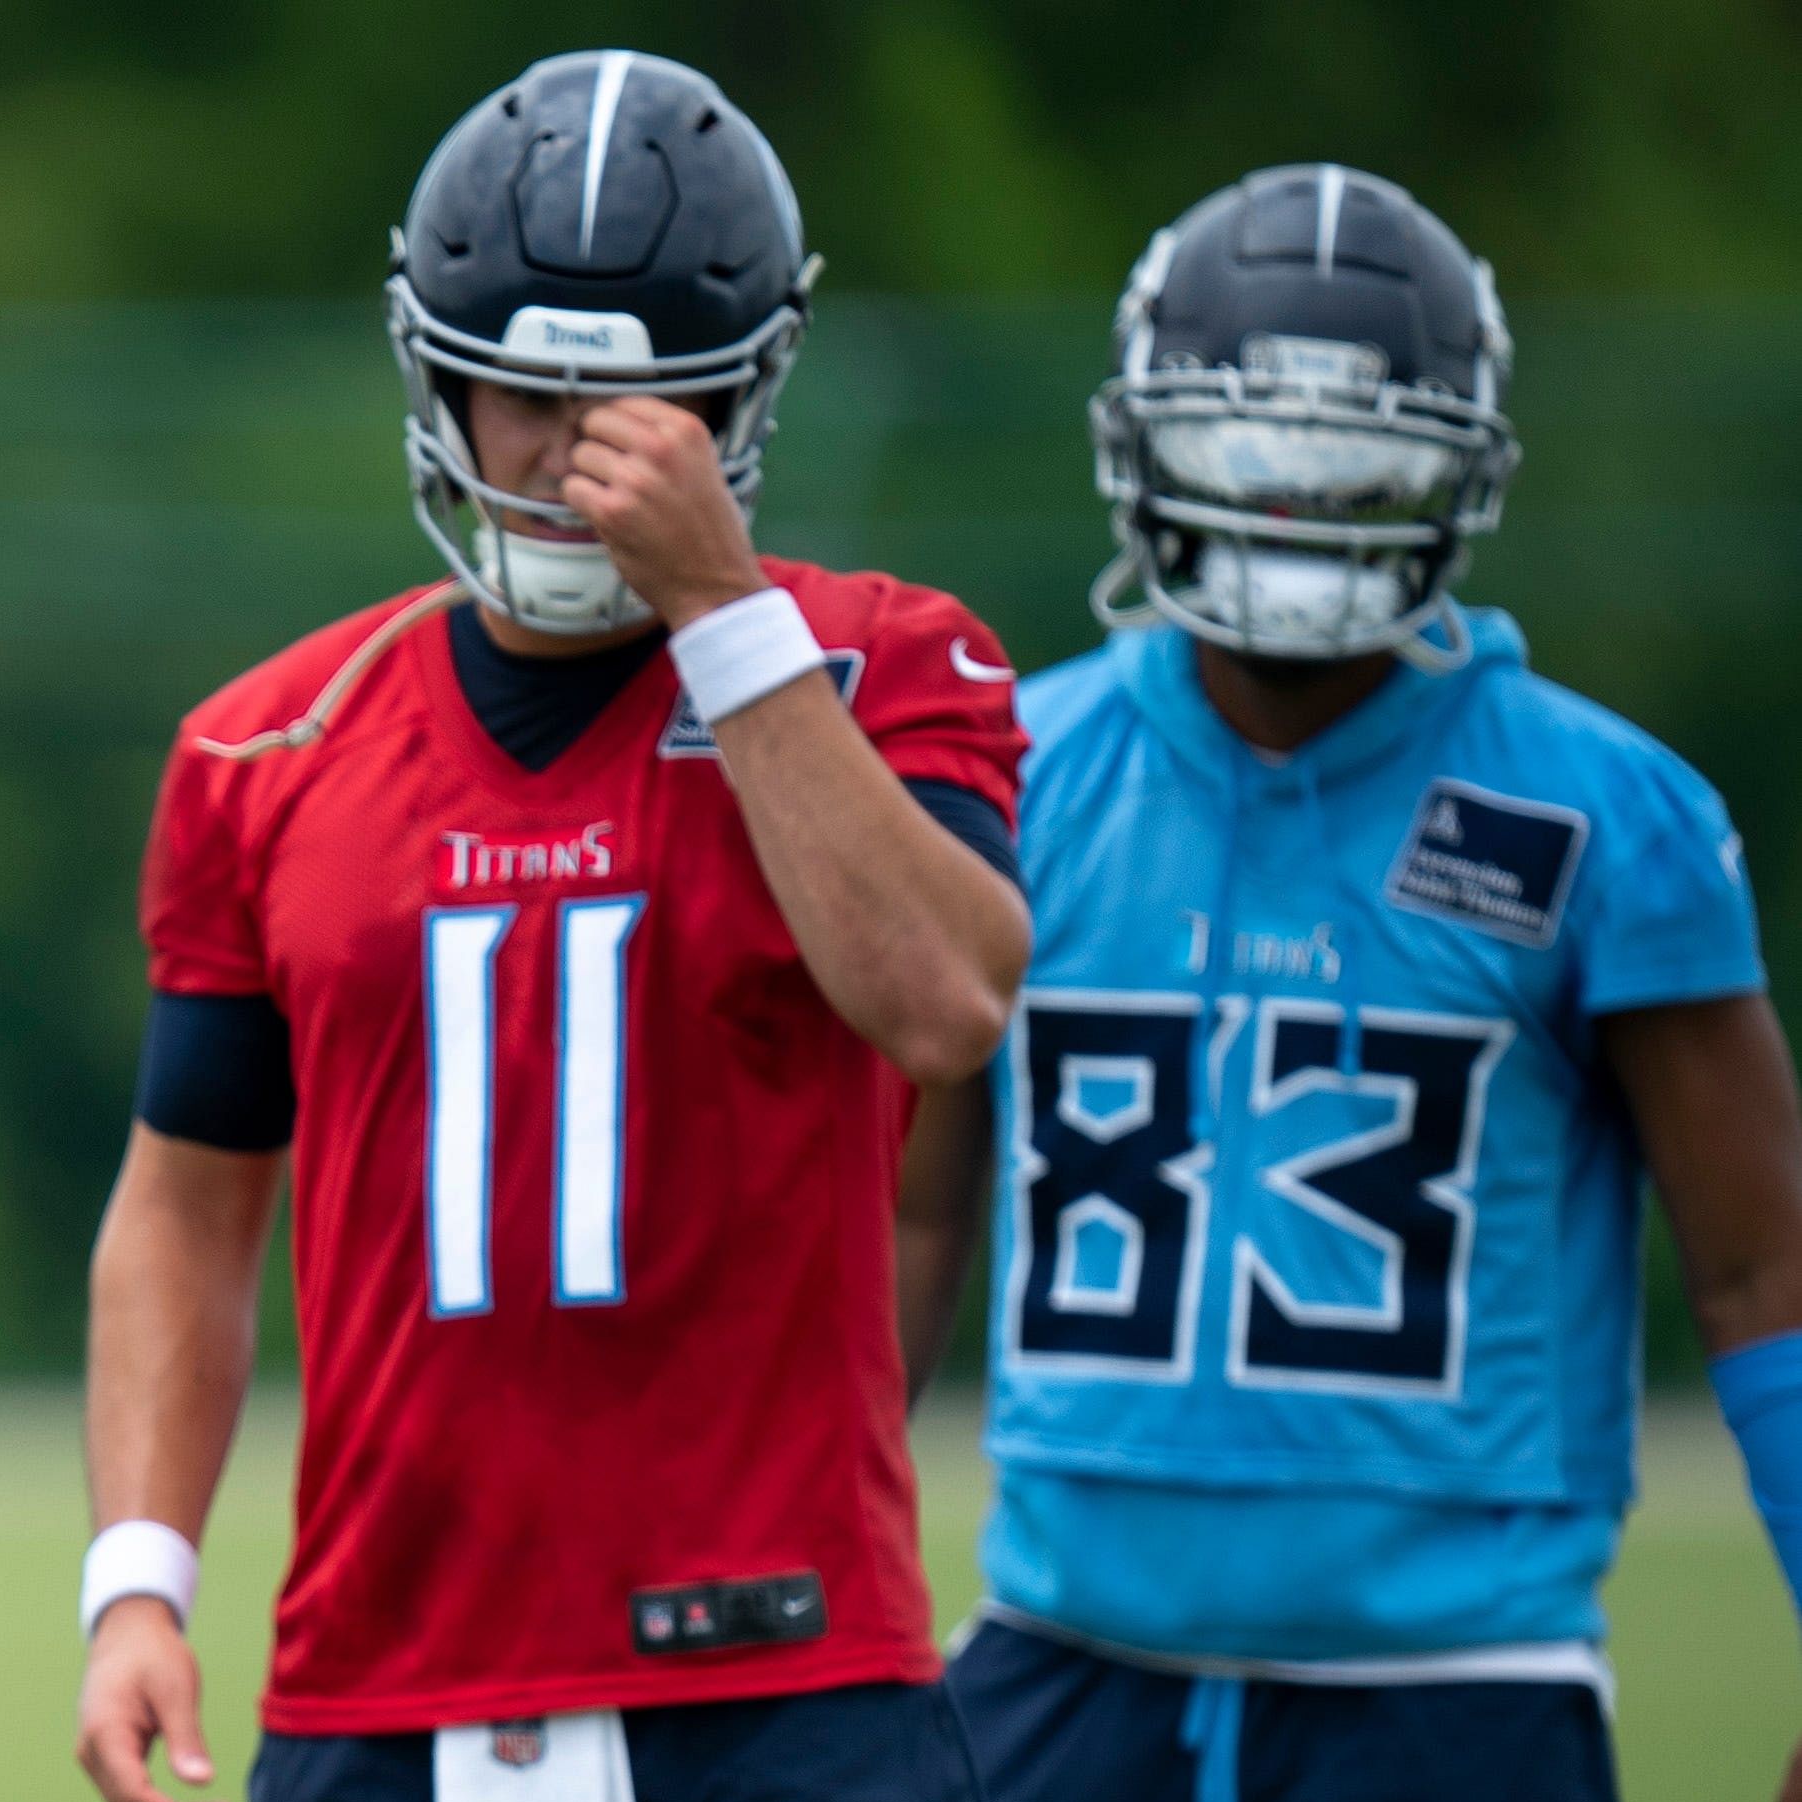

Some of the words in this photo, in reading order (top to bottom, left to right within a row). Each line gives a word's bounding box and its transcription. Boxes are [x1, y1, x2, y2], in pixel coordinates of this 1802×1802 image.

[439, 818, 614, 888] TITANS
[423, 892, 651, 1320] 11
[1004, 987, 1518, 1399] 83
